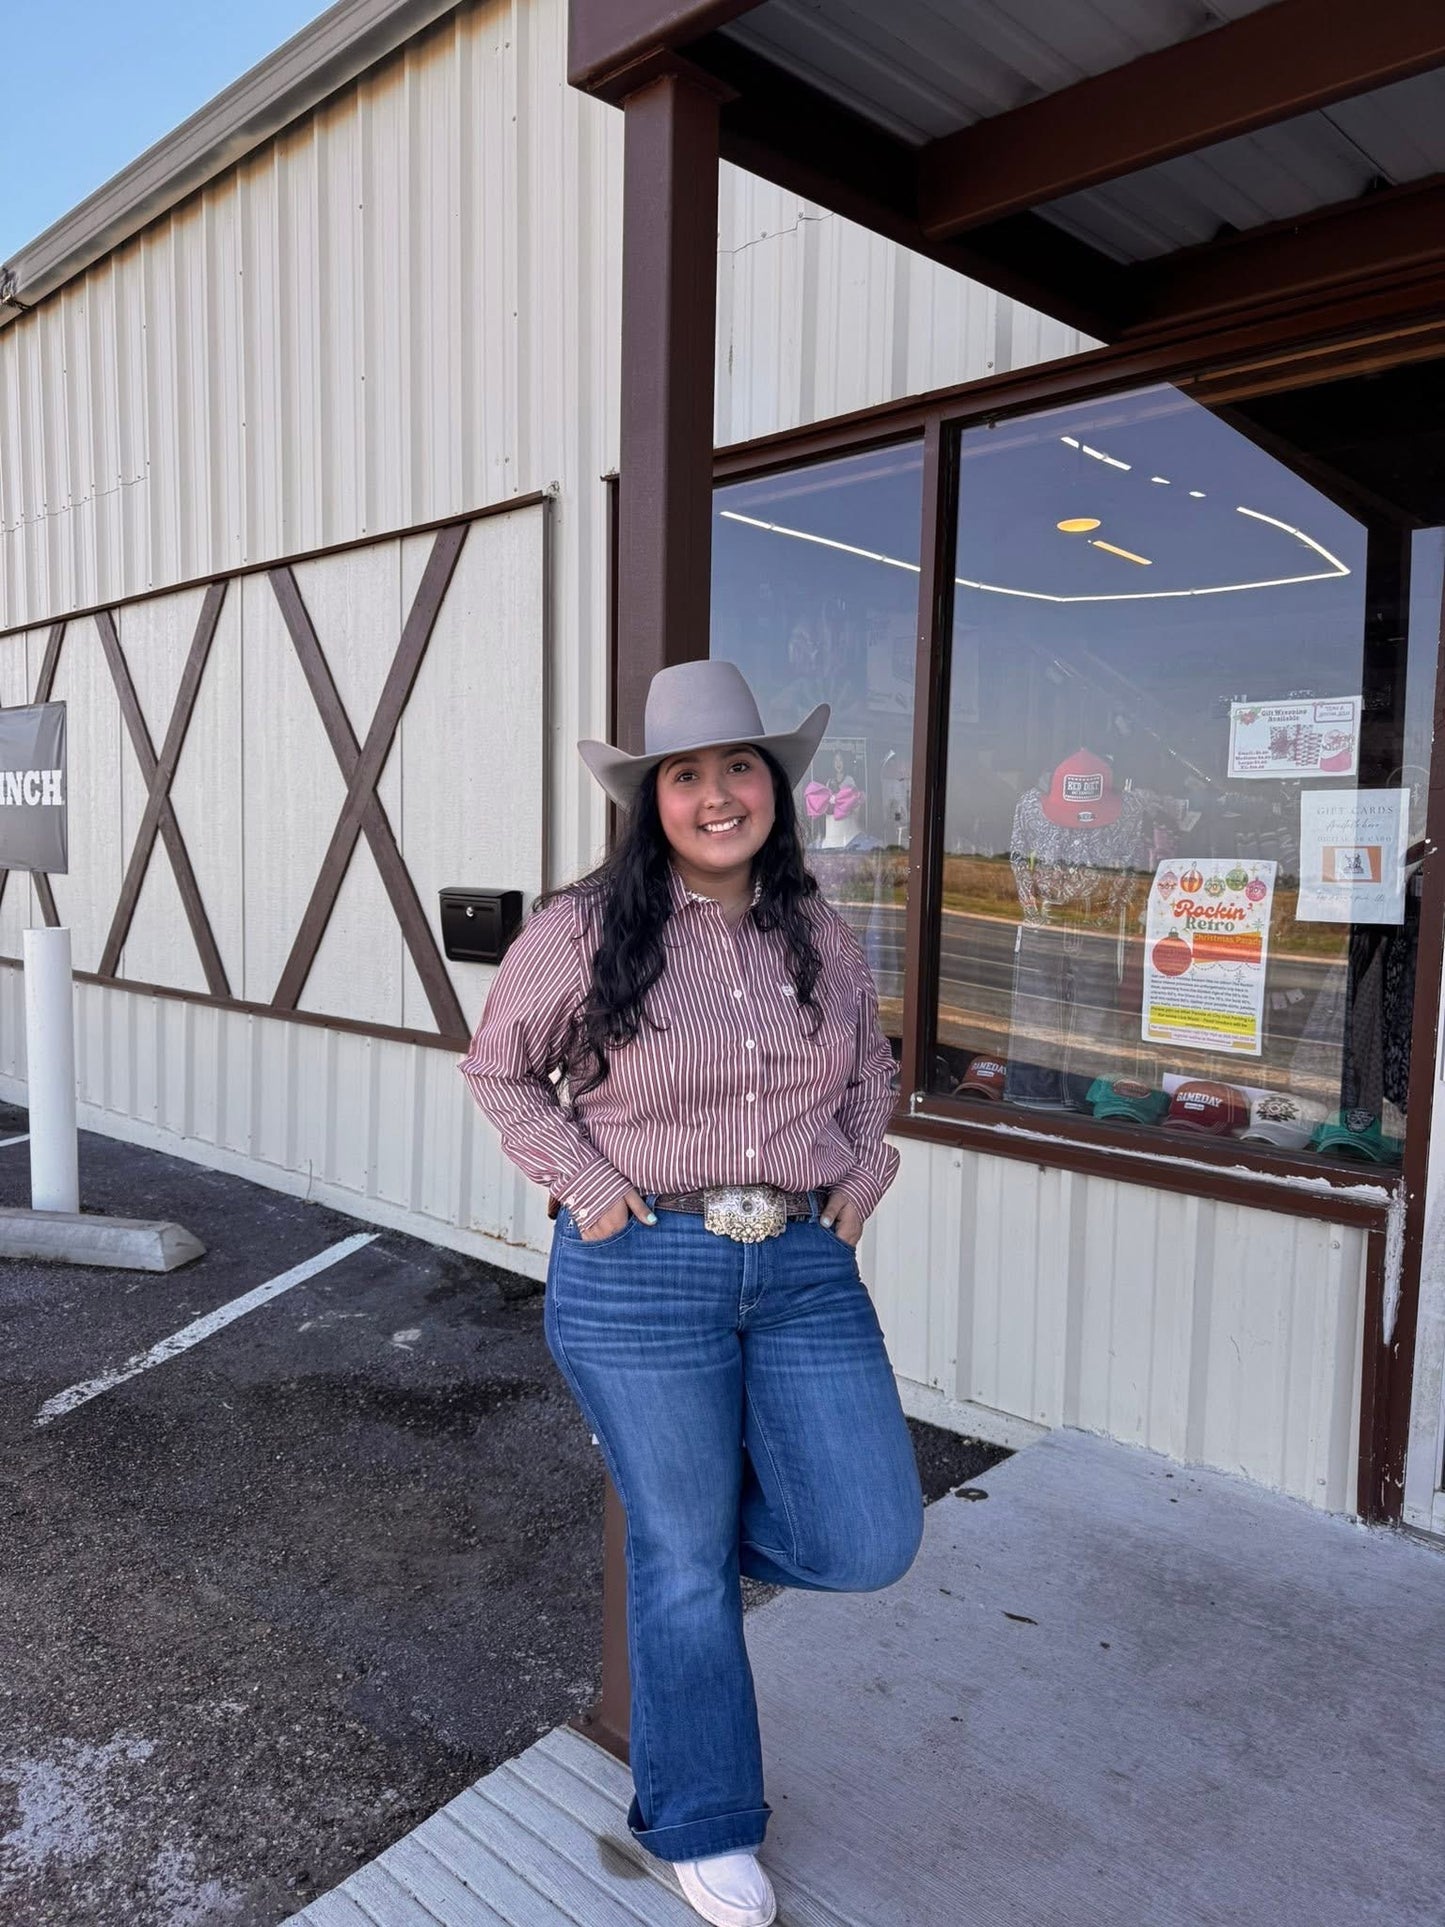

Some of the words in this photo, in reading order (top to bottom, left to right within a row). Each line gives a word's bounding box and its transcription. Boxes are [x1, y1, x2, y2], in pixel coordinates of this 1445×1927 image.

[1067, 781, 1082, 791] RED
[1317, 807, 1345, 815] GIFT
[1351, 805, 1393, 815] CARDS
[1174, 899, 1254, 921] Rockin'
[1185, 917, 1235, 932] Retro
[1193, 934, 1234, 944] Christmas
[1176, 1091, 1223, 1109] GAMEDAY
